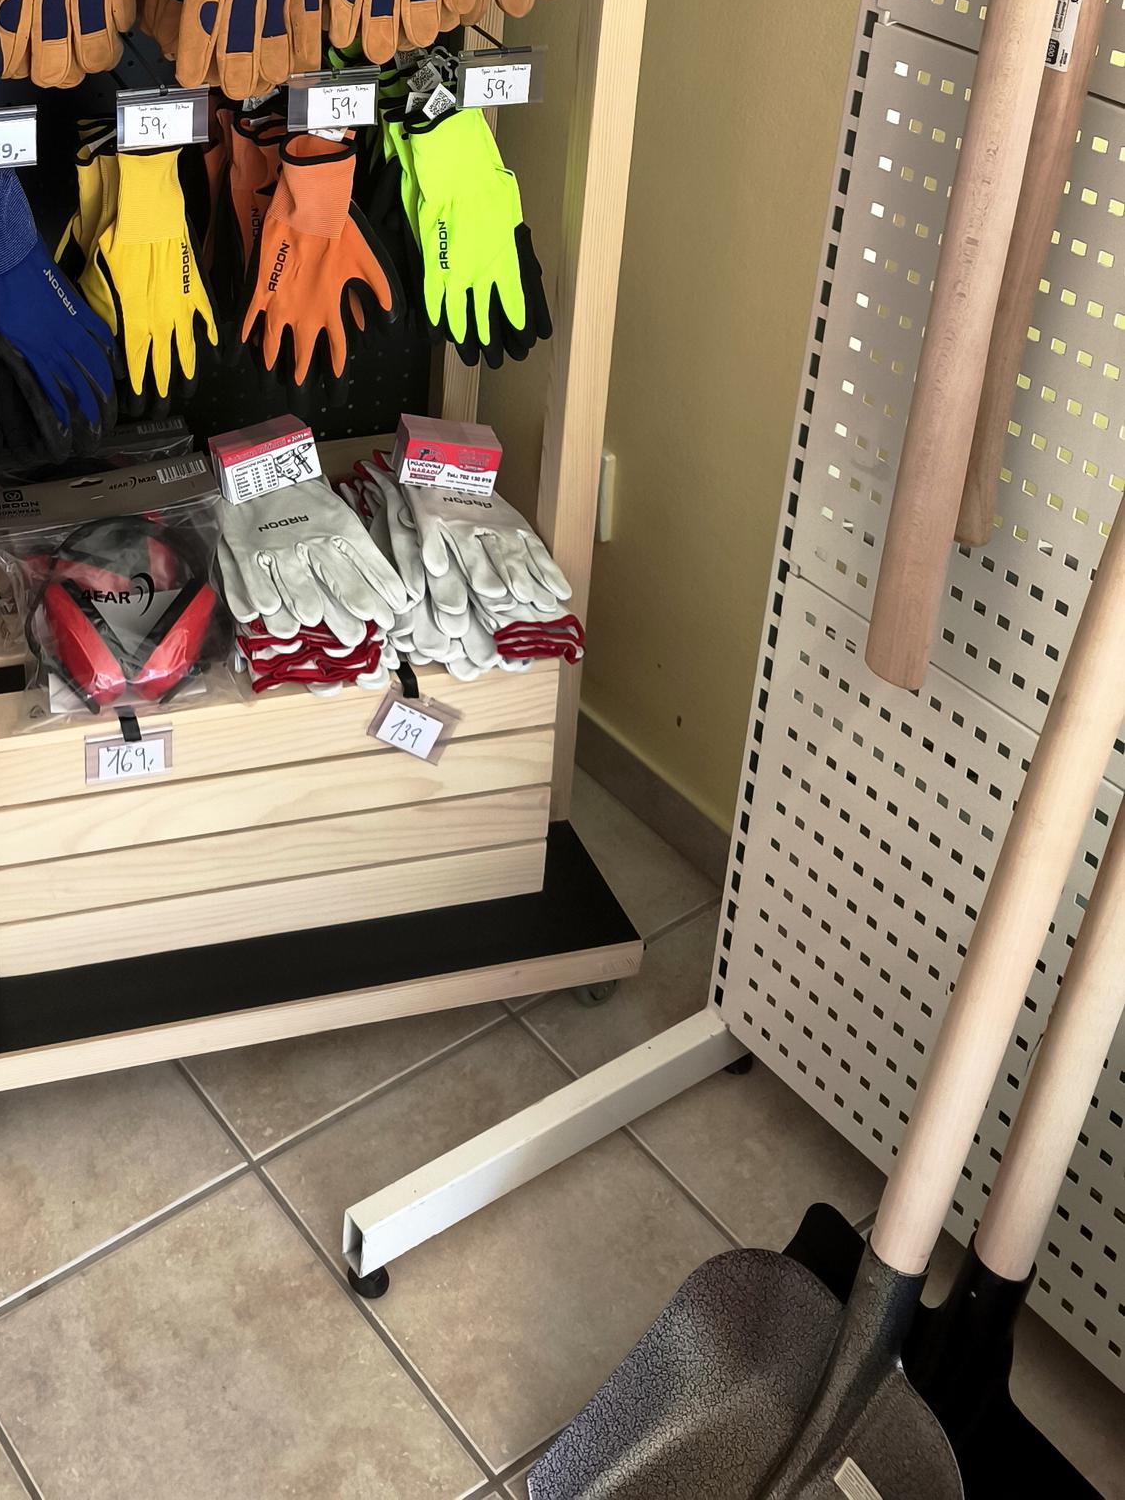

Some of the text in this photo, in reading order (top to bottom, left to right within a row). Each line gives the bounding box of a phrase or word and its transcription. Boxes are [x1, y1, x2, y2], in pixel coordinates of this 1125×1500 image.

[268, 241, 291, 292] ARDON
[440, 220, 451, 270] ARDON
[44, 268, 78, 317] ARDON
[183, 246, 191, 295] ARDON
[138, 475, 157, 485] M20
[259, 514, 309, 533] ARDON
[82, 589, 131, 605] 4EAR
